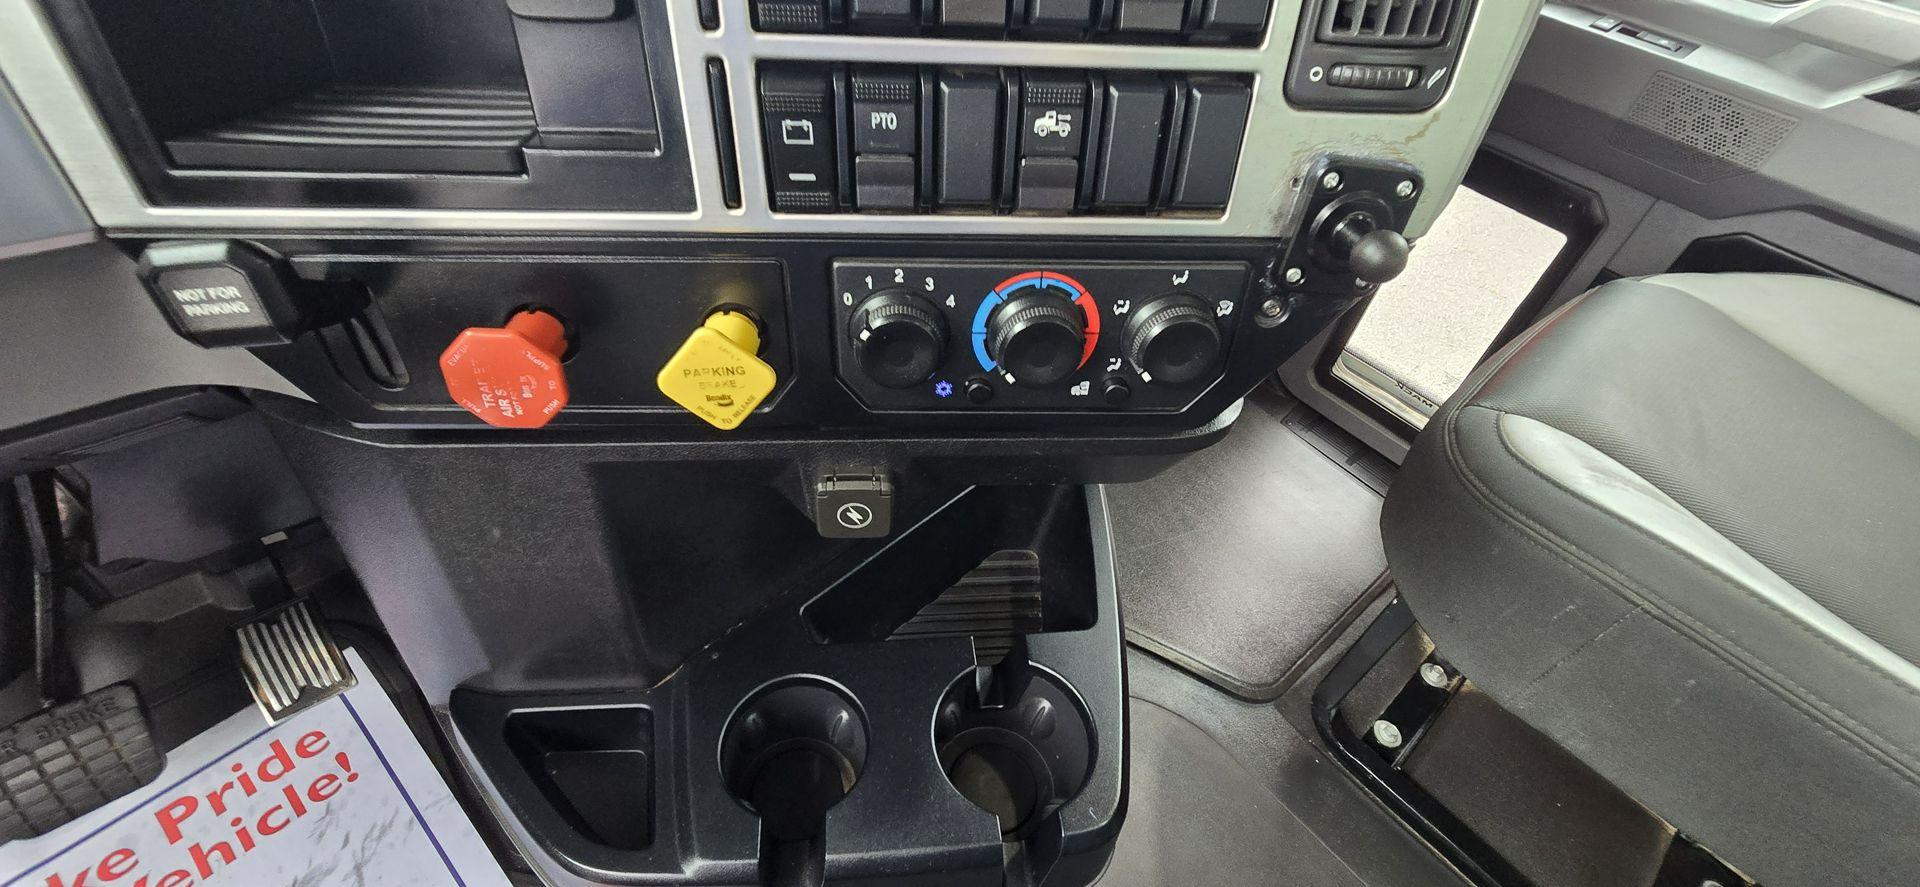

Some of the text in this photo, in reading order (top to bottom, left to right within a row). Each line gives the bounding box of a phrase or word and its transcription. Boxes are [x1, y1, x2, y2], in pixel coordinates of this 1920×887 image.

[871, 112, 897, 131] PTO
[172, 285, 243, 302] NOT FOR
[843, 269, 956, 308] 0 1 2 3 4
[181, 301, 250, 318] PARKING
[498, 398, 515, 418] AIR
[542, 398, 560, 415] PUSH
[720, 418, 733, 426] TO
[154, 729, 330, 846] Pride
